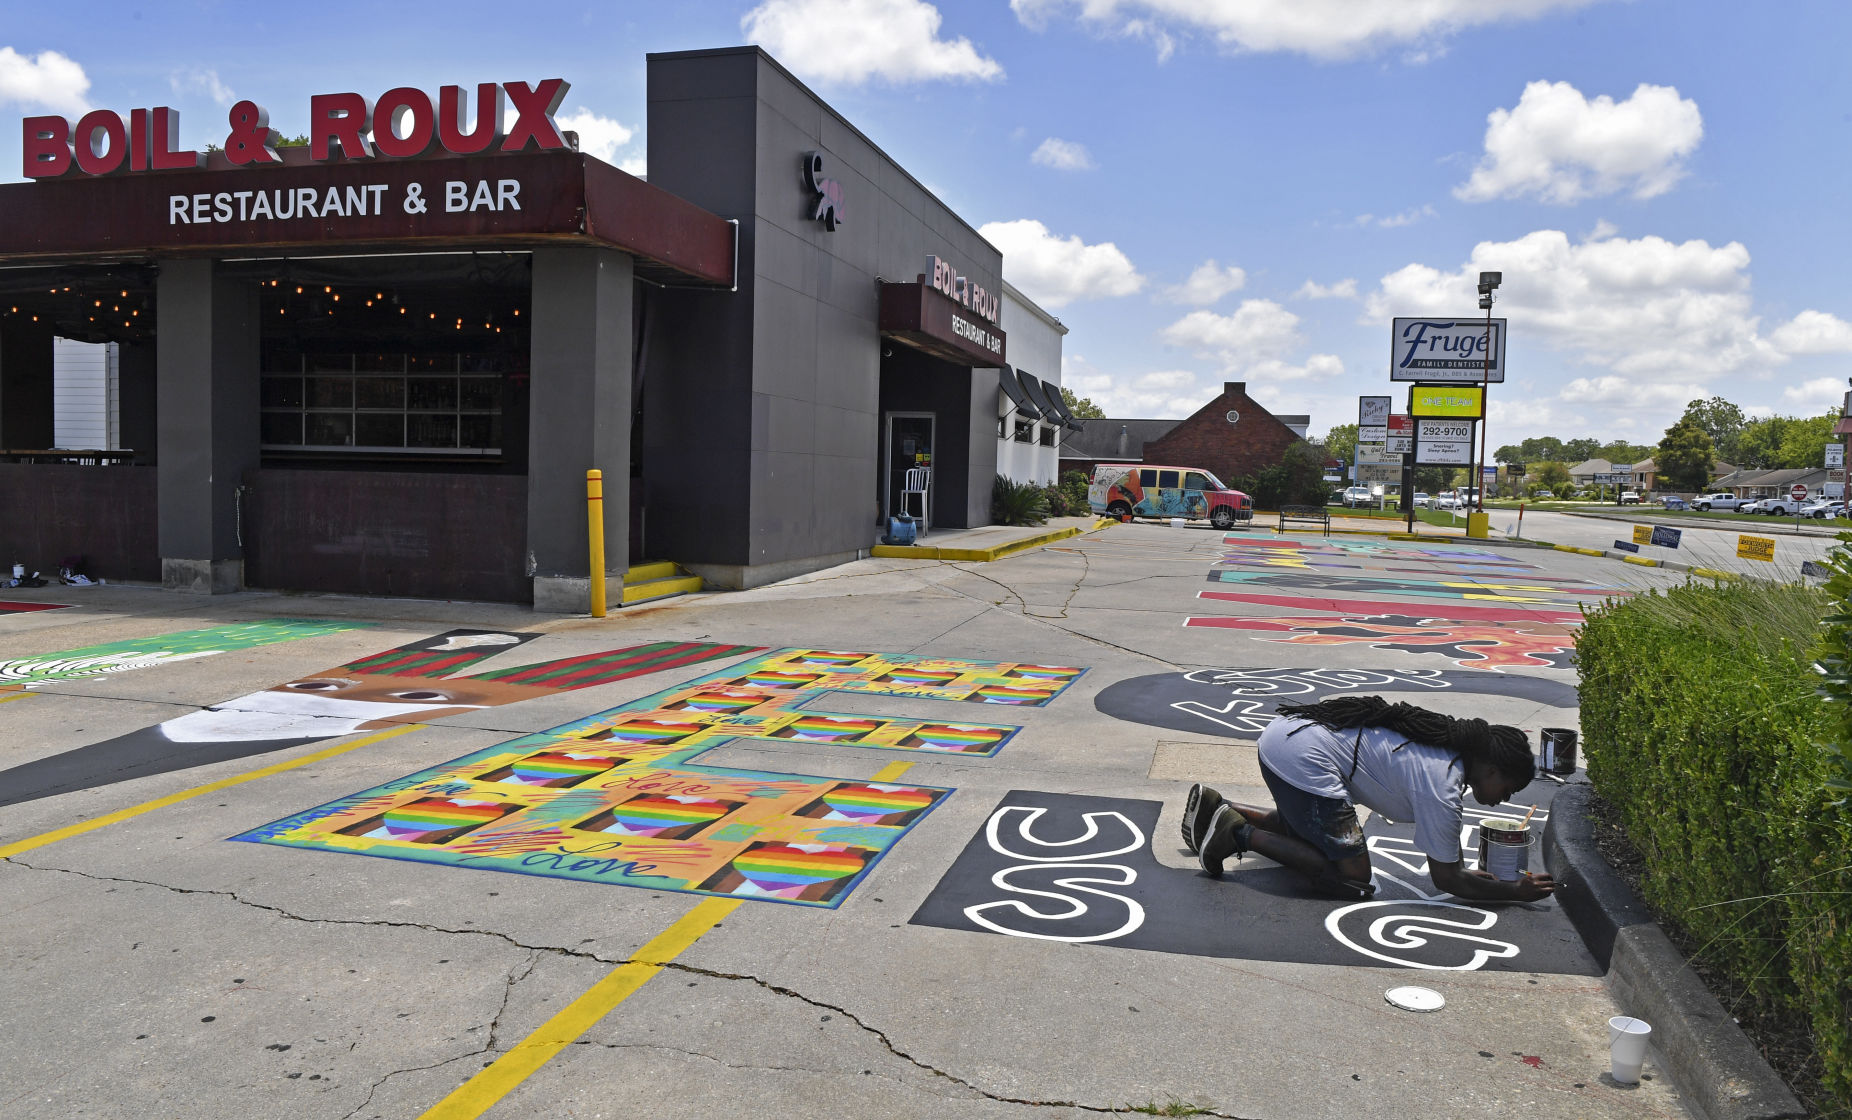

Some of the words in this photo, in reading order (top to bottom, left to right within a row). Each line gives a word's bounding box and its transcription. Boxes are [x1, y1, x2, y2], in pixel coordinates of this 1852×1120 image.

[23, 106, 197, 179] BOIL
[226, 100, 274, 166] &
[311, 78, 571, 161] ROUX
[169, 185, 388, 224] RESTAURANT
[403, 183, 427, 215] &
[445, 180, 521, 213] BAR
[933, 255, 960, 300] BOIL
[972, 283, 998, 323] ROUX
[952, 314, 985, 347] RESTAURANT
[986, 333, 991, 349] &
[991, 338, 1001, 355] BAR
[1400, 322, 1491, 368] Frugé
[1422, 397, 1442, 406] ONE
[1445, 397, 1473, 407] TEAM
[1423, 427, 1468, 436] 292-9700
[1748, 544, 1767, 553] JUDGE
[522, 841, 671, 879] Love
